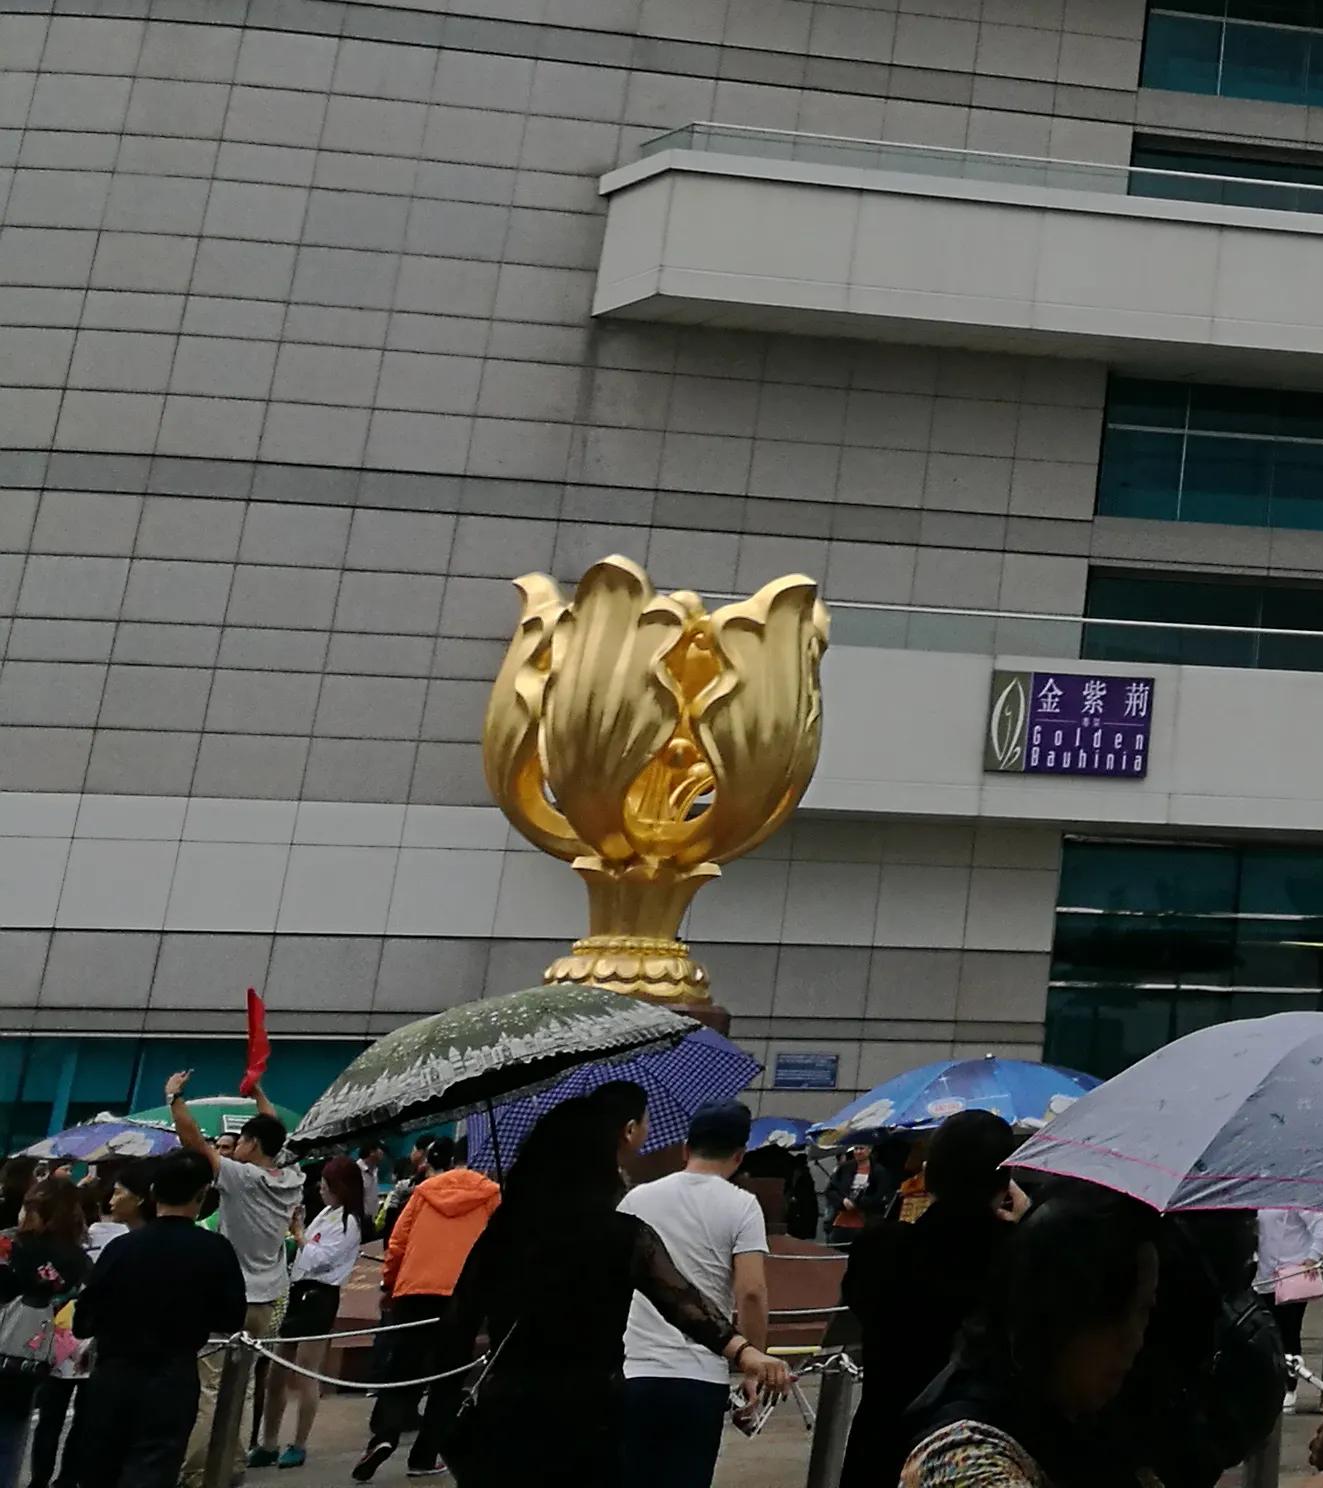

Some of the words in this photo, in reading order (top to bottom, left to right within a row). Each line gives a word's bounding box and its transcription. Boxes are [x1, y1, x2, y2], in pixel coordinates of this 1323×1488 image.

[1037, 677, 1150, 718] 金紫荊
[1032, 725, 1144, 750] Golden
[1030, 746, 1142, 771] Bauhinia
